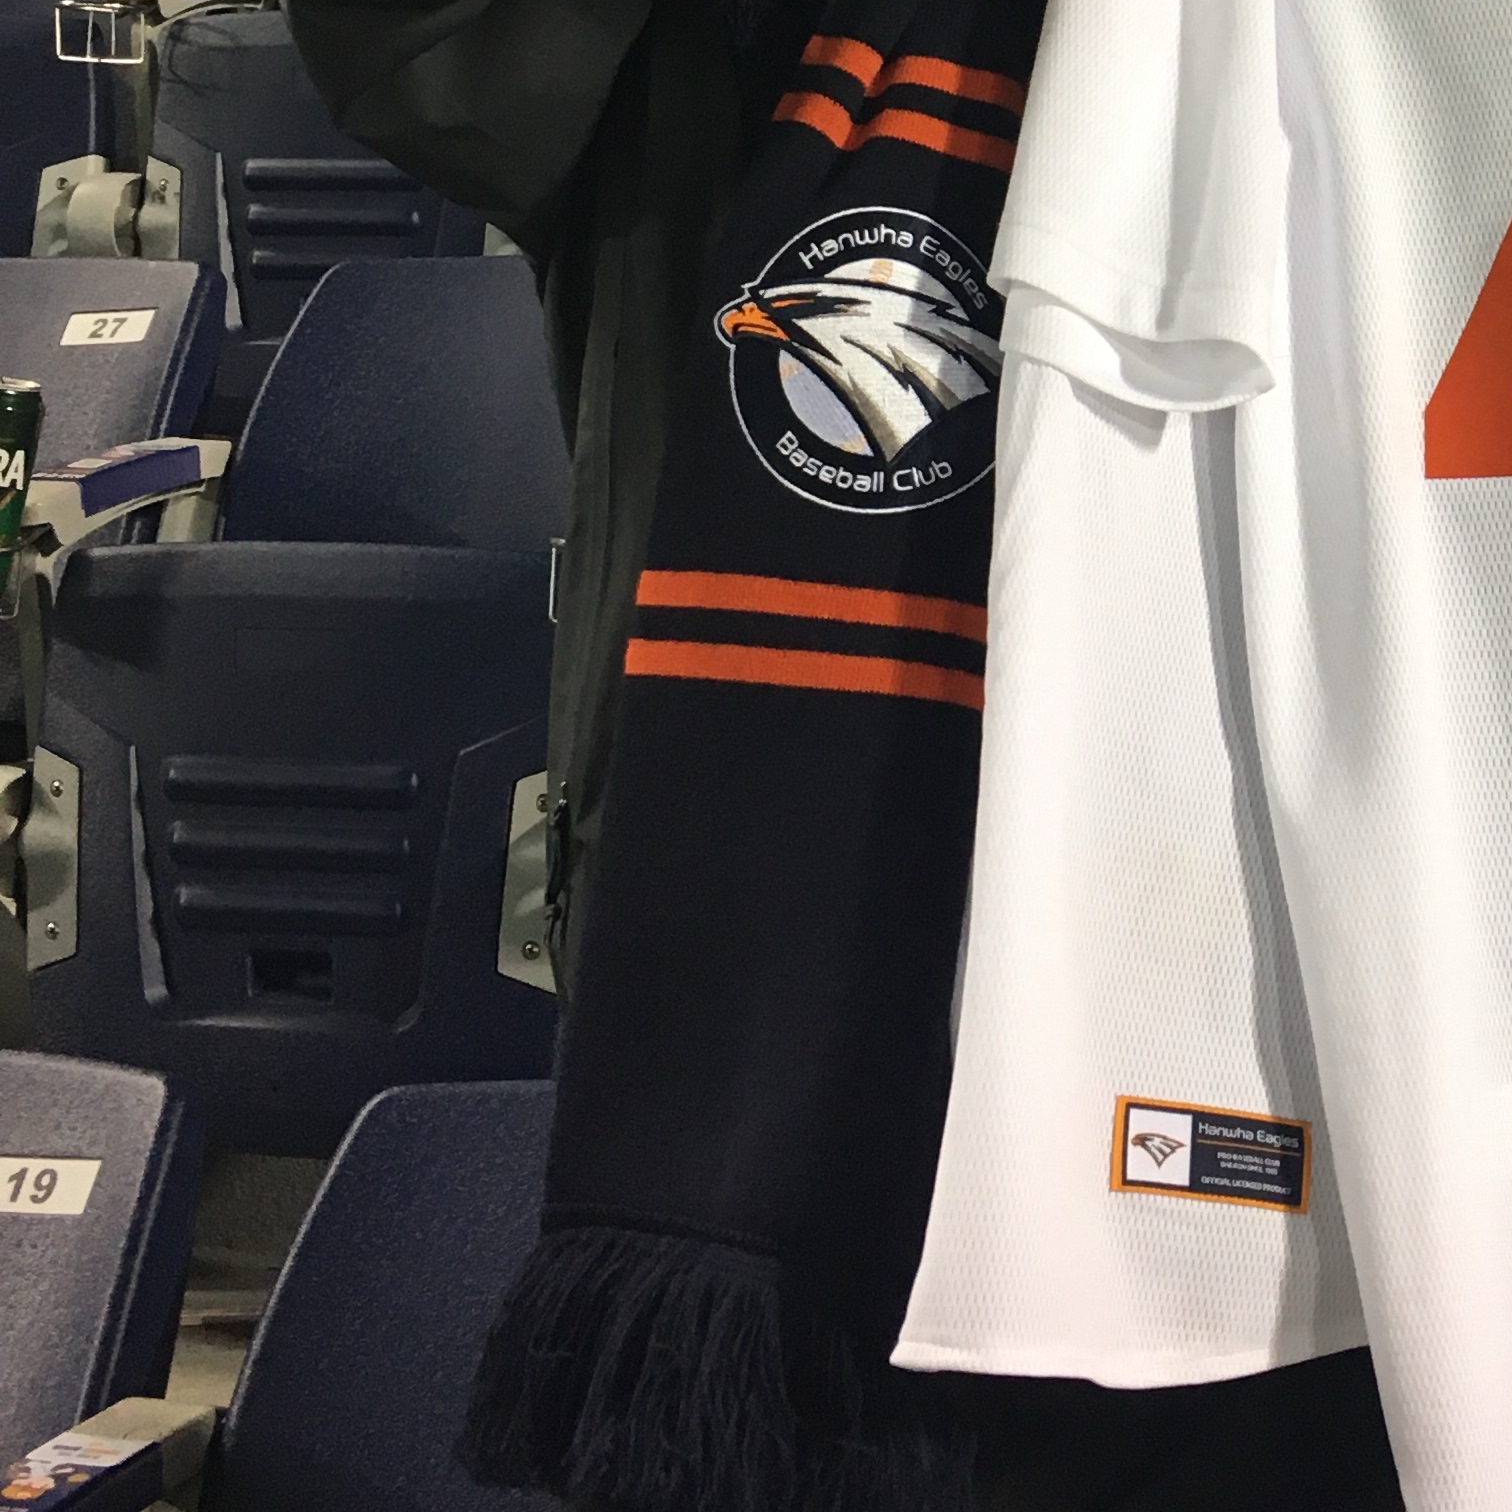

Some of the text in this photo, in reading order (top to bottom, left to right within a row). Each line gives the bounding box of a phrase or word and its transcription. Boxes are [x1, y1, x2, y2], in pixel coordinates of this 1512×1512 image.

[799, 224, 989, 310] Hanwha Eagles
[88, 318, 128, 338] 27
[775, 430, 952, 492] Baseball Club
[1198, 1121, 1299, 1148] Hanwha Eagles
[7, 1167, 58, 1205] 19
